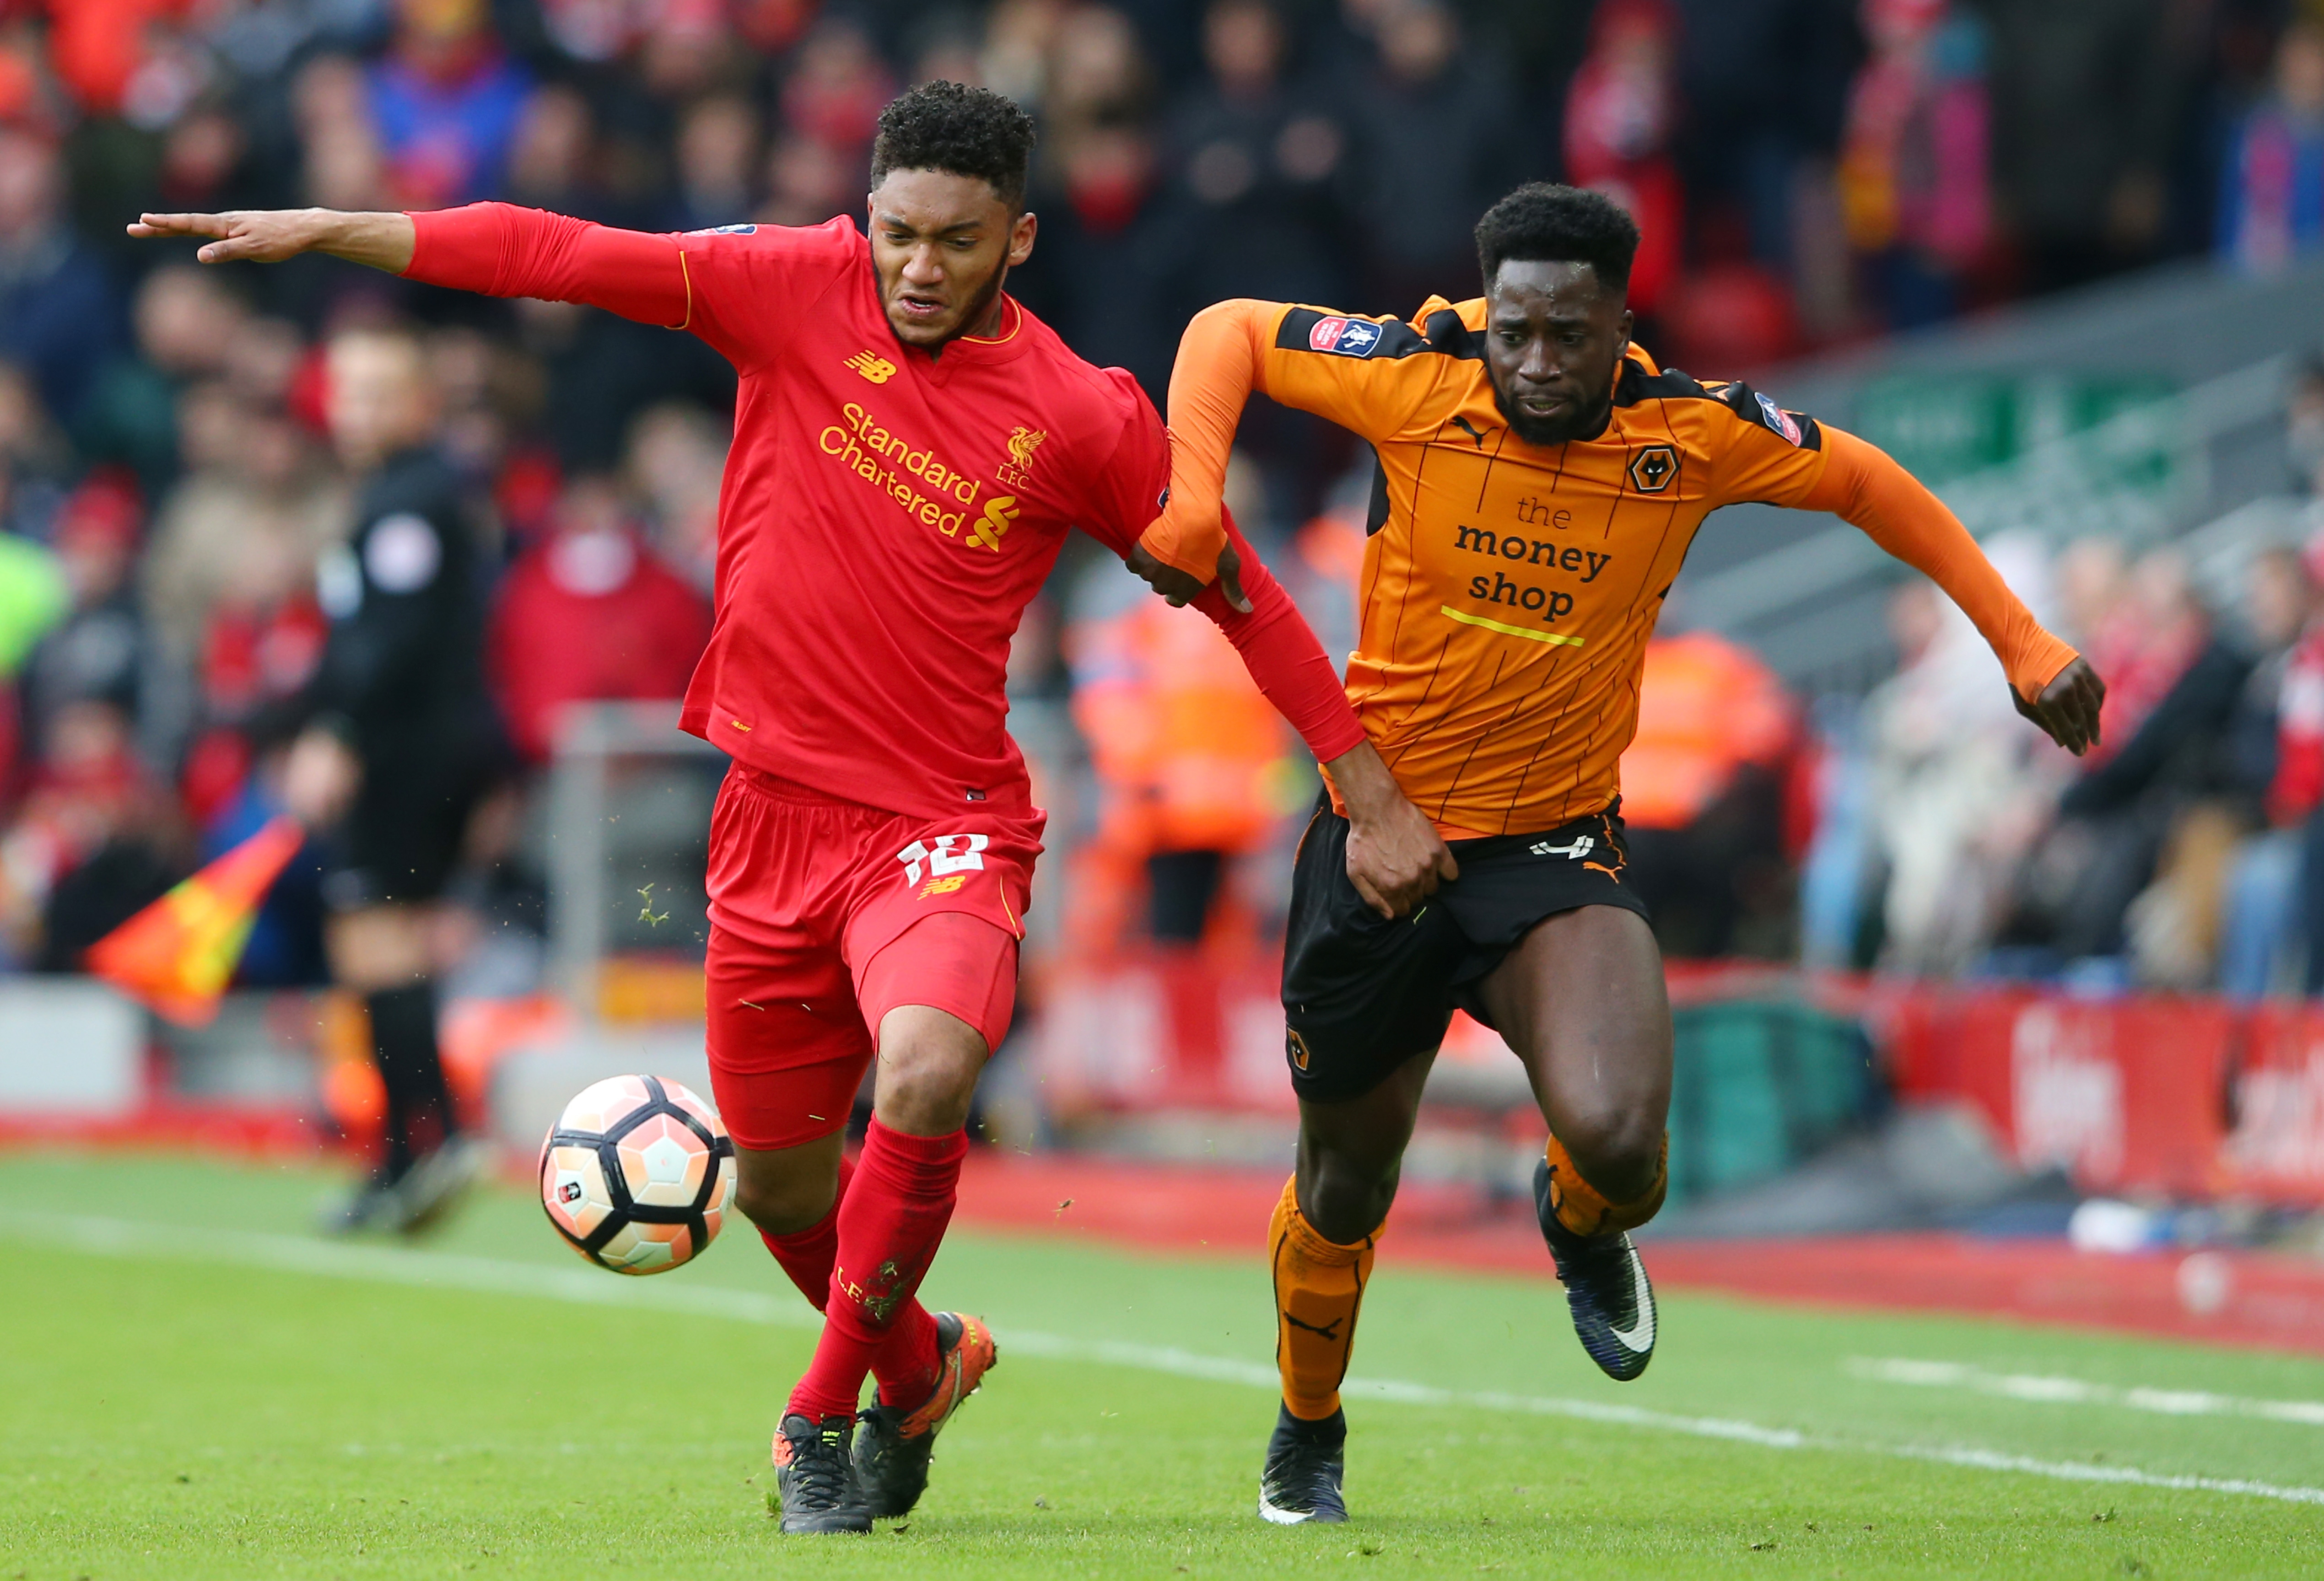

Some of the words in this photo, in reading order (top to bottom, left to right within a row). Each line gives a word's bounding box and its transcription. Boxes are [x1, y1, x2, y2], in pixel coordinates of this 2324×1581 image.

[842, 402, 981, 505] Standard
[996, 465, 1030, 491] L.F.C.
[819, 426, 966, 538] Chartered
[1517, 497, 1571, 530] the
[1454, 524, 1612, 583] money
[1468, 571, 1574, 623] shop
